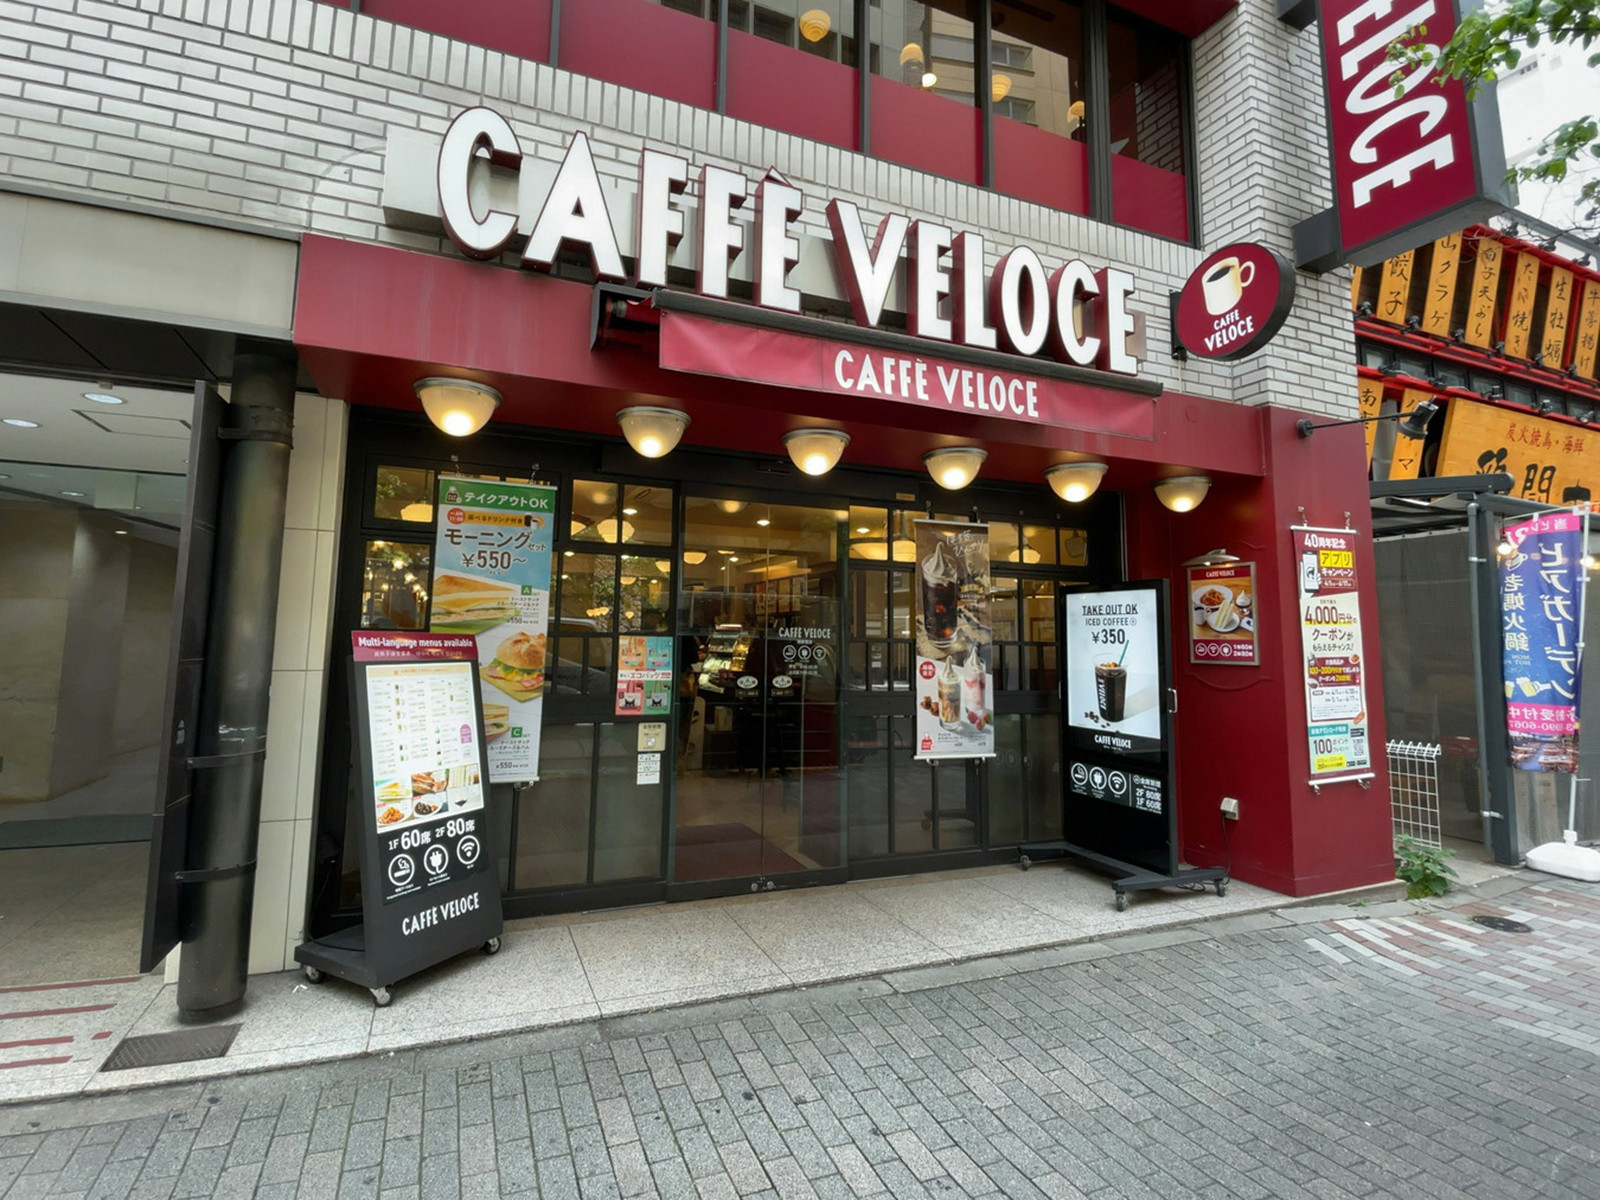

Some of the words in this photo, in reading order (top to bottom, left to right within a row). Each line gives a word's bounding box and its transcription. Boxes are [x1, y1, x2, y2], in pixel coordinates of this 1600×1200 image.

[437, 106, 802, 313] CAFFÈ
[826, 197, 1141, 376] VELOCE
[1475, 246, 1497, 339] 白子天ぷら
[1204, 315, 1254, 352] VELOCE
[833, 349, 928, 399] CAFFÈ
[937, 364, 1040, 419] VELOCE
[464, 491, 549, 510] テイクアウトOK
[1321, 552, 1352, 566] アプリ
[1321, 568, 1353, 577] キャンペーン
[1082, 604, 1103, 616] TAKE
[1105, 603, 1124, 615] OUT
[1125, 602, 1139, 614] OK
[1085, 617, 1101, 626] ICED
[1102, 616, 1129, 627] COFFEE
[804, 627, 831, 639] VELOCE
[1091, 628, 1126, 645] ¥350
[1312, 628, 1354, 641] クーポンが
[358, 636, 418, 649] Multi-language
[419, 637, 443, 647] menus
[443, 637, 474, 647] available
[1111, 736, 1132, 750] VELOCE
[1313, 738, 1333, 754] 100
[388, 839, 399, 851] 1F
[401, 829, 432, 850] 60席
[435, 827, 446, 838] 2F
[446, 818, 475, 838] 80席
[440, 892, 480, 921] VELOCE
